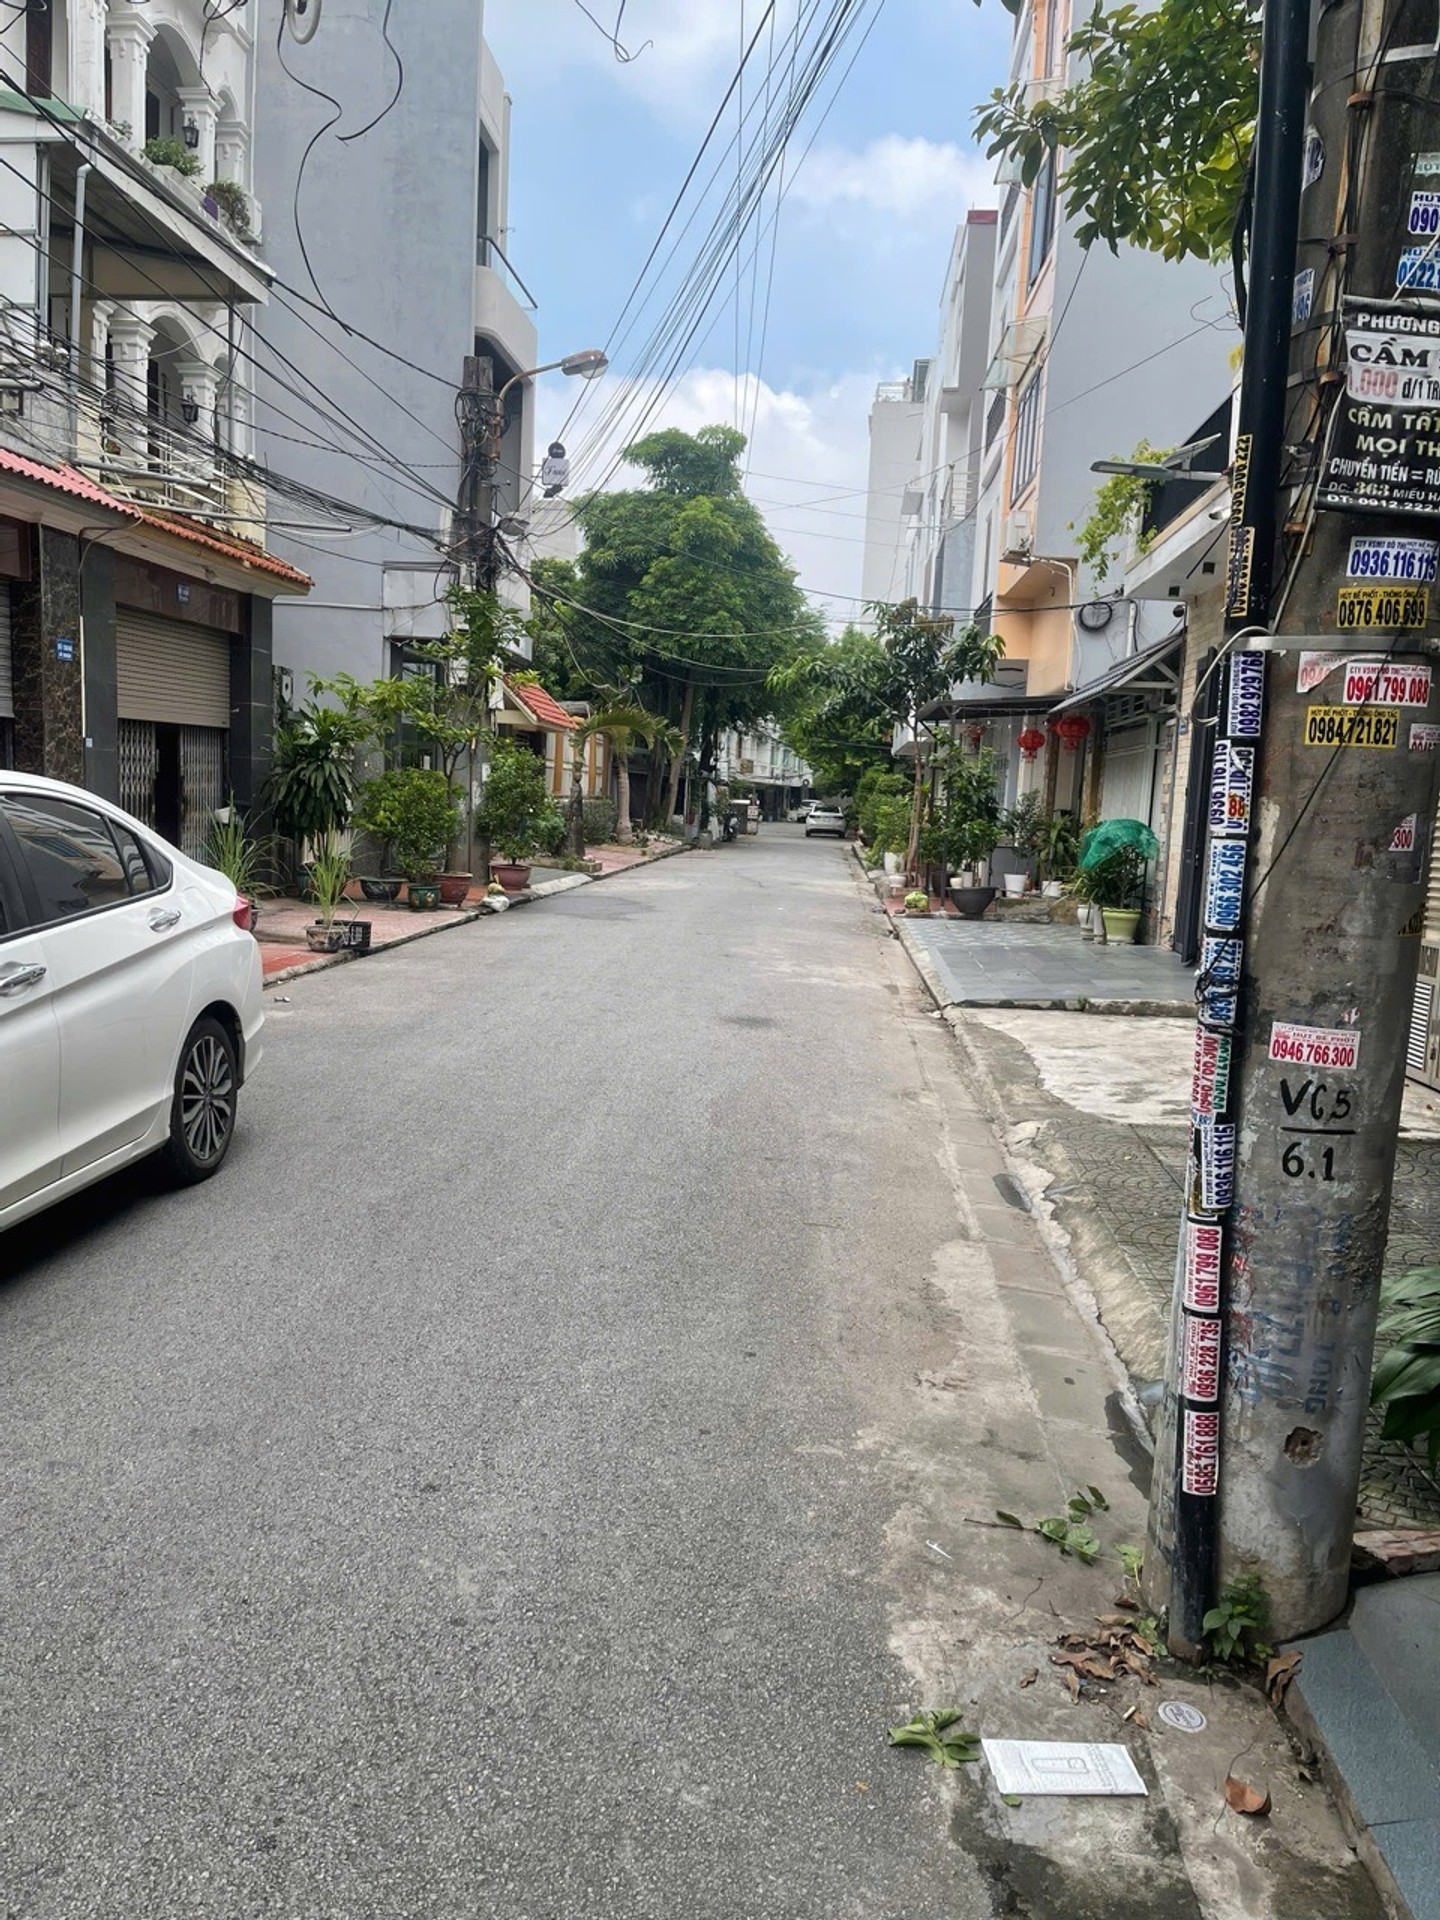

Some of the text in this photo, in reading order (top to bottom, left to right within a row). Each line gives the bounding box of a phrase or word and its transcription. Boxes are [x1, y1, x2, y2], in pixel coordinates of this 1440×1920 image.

[1411, 207, 1440, 232] 090
[1350, 337, 1430, 368] CẦM
[1348, 405, 1393, 429] CẦM
[1356, 434, 1407, 458] MỌI
[1353, 482, 1390, 497] 363
[1358, 497, 1440, 512] 0912.222.
[1350, 549, 1437, 580] 0936.116.115
[1238, 651, 1264, 735] 0982.929.768
[1346, 676, 1430, 704] 0961.799.088
[1309, 717, 1398, 745] 0984.721.821
[1210, 743, 1228, 826] 0936.116.115
[1215, 844, 1245, 926] 0966.302.456
[1272, 1039, 1355, 1067] 0946.766.300
[1282, 1141, 1335, 1182] 6.1
[1195, 1228, 1220, 1307] 0961.799.088
[1196, 1321, 1220, 1398] 0936.228.735
